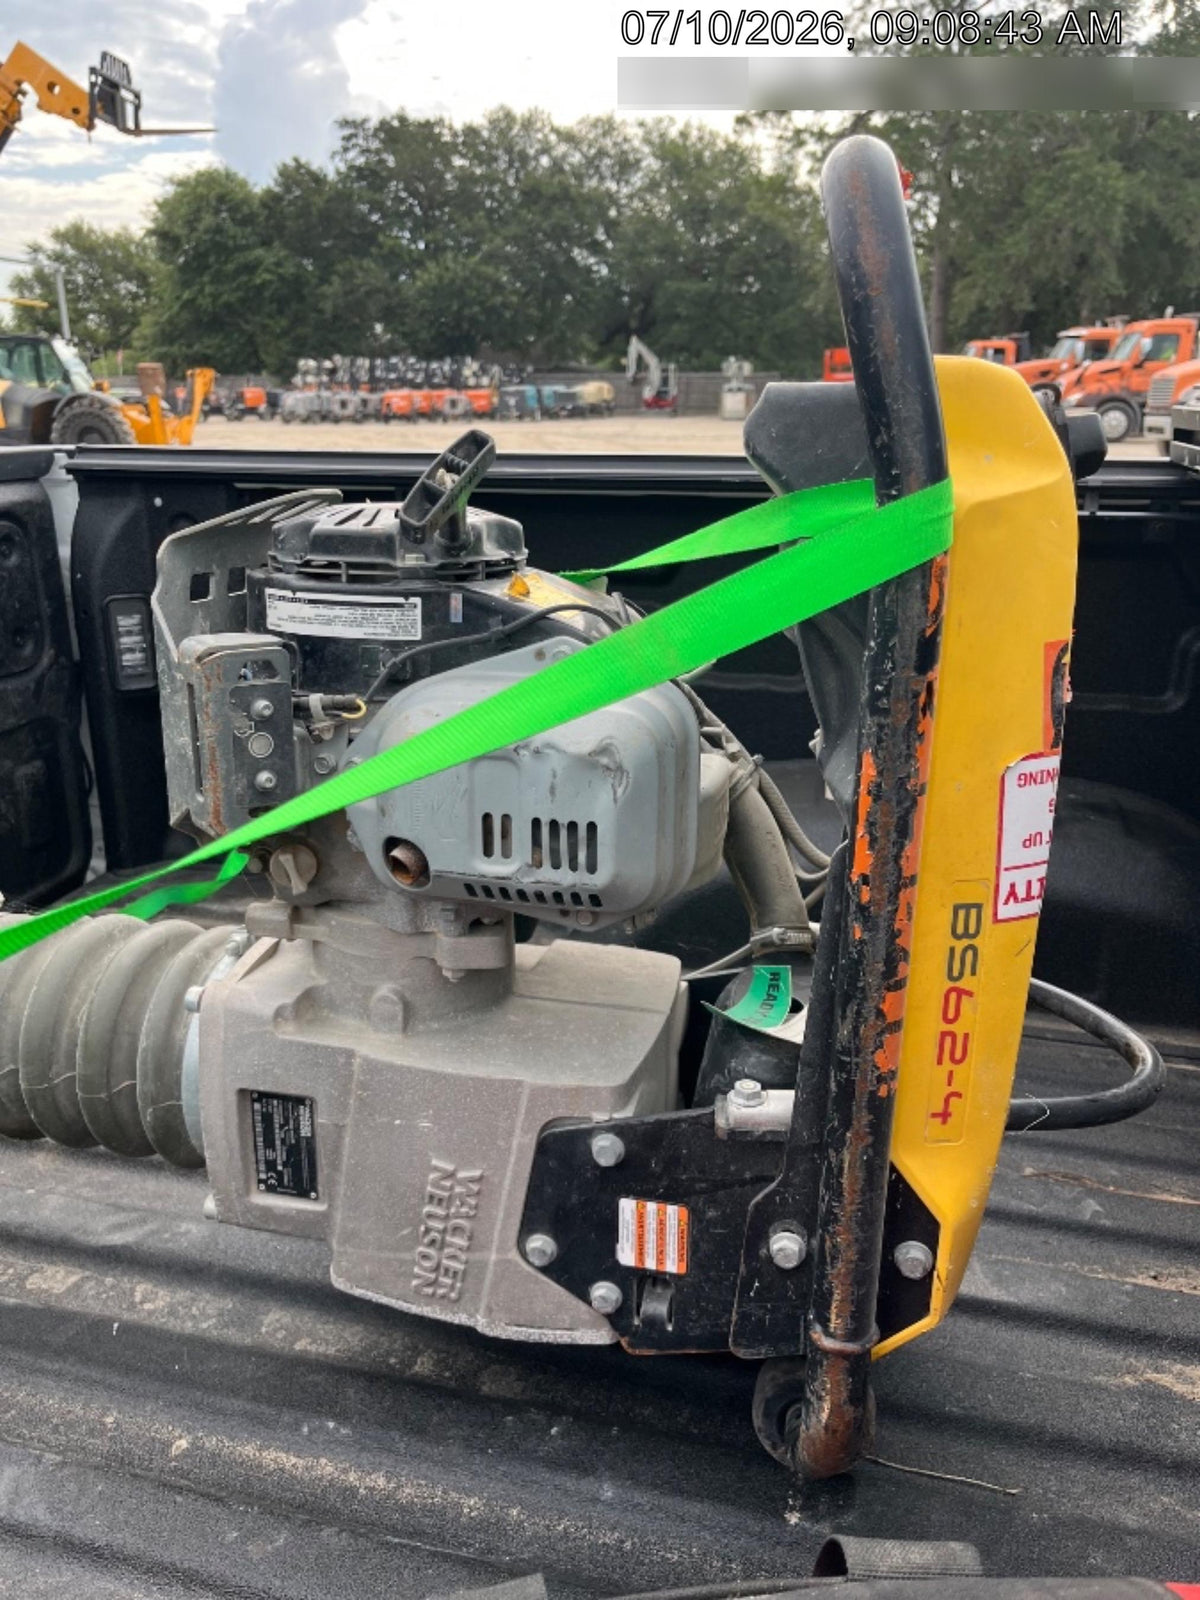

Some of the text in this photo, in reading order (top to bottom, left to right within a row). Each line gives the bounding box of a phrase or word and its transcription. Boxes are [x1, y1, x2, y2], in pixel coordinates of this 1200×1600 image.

[1022, 831, 1042, 849] UP
[754, 971, 781, 1018] READY
[930, 903, 984, 1125] BS62-4
[411, 1157, 456, 1297] NEUSON
[435, 1169, 484, 1299] WACKER
